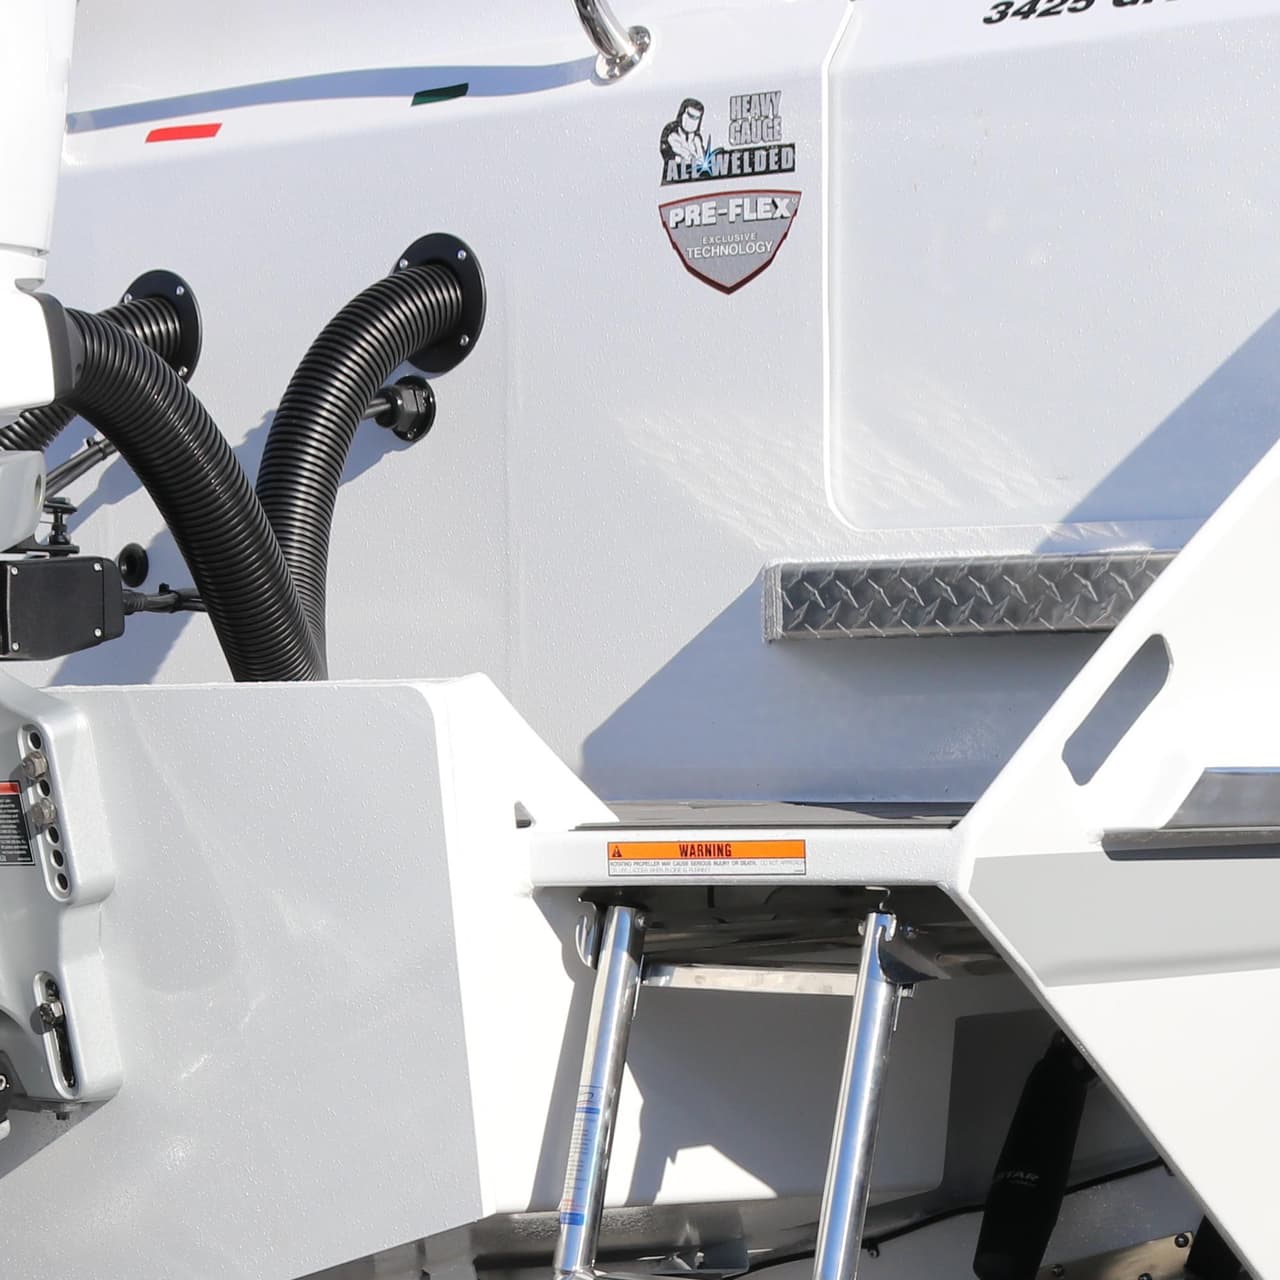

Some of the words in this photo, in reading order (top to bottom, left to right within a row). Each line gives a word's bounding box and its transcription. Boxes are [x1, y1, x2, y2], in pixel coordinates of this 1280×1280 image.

[982, 0, 1095, 25] 3425
[729, 91, 782, 120] HEAVY
[728, 117, 783, 146] GAUGE
[710, 147, 794, 177] WELDED
[669, 198, 791, 229] PRE-FLEX
[686, 240, 774, 259] TECHNOLOGY
[702, 232, 757, 245] EXCLUSIVE
[678, 843, 732, 858] WARNING
